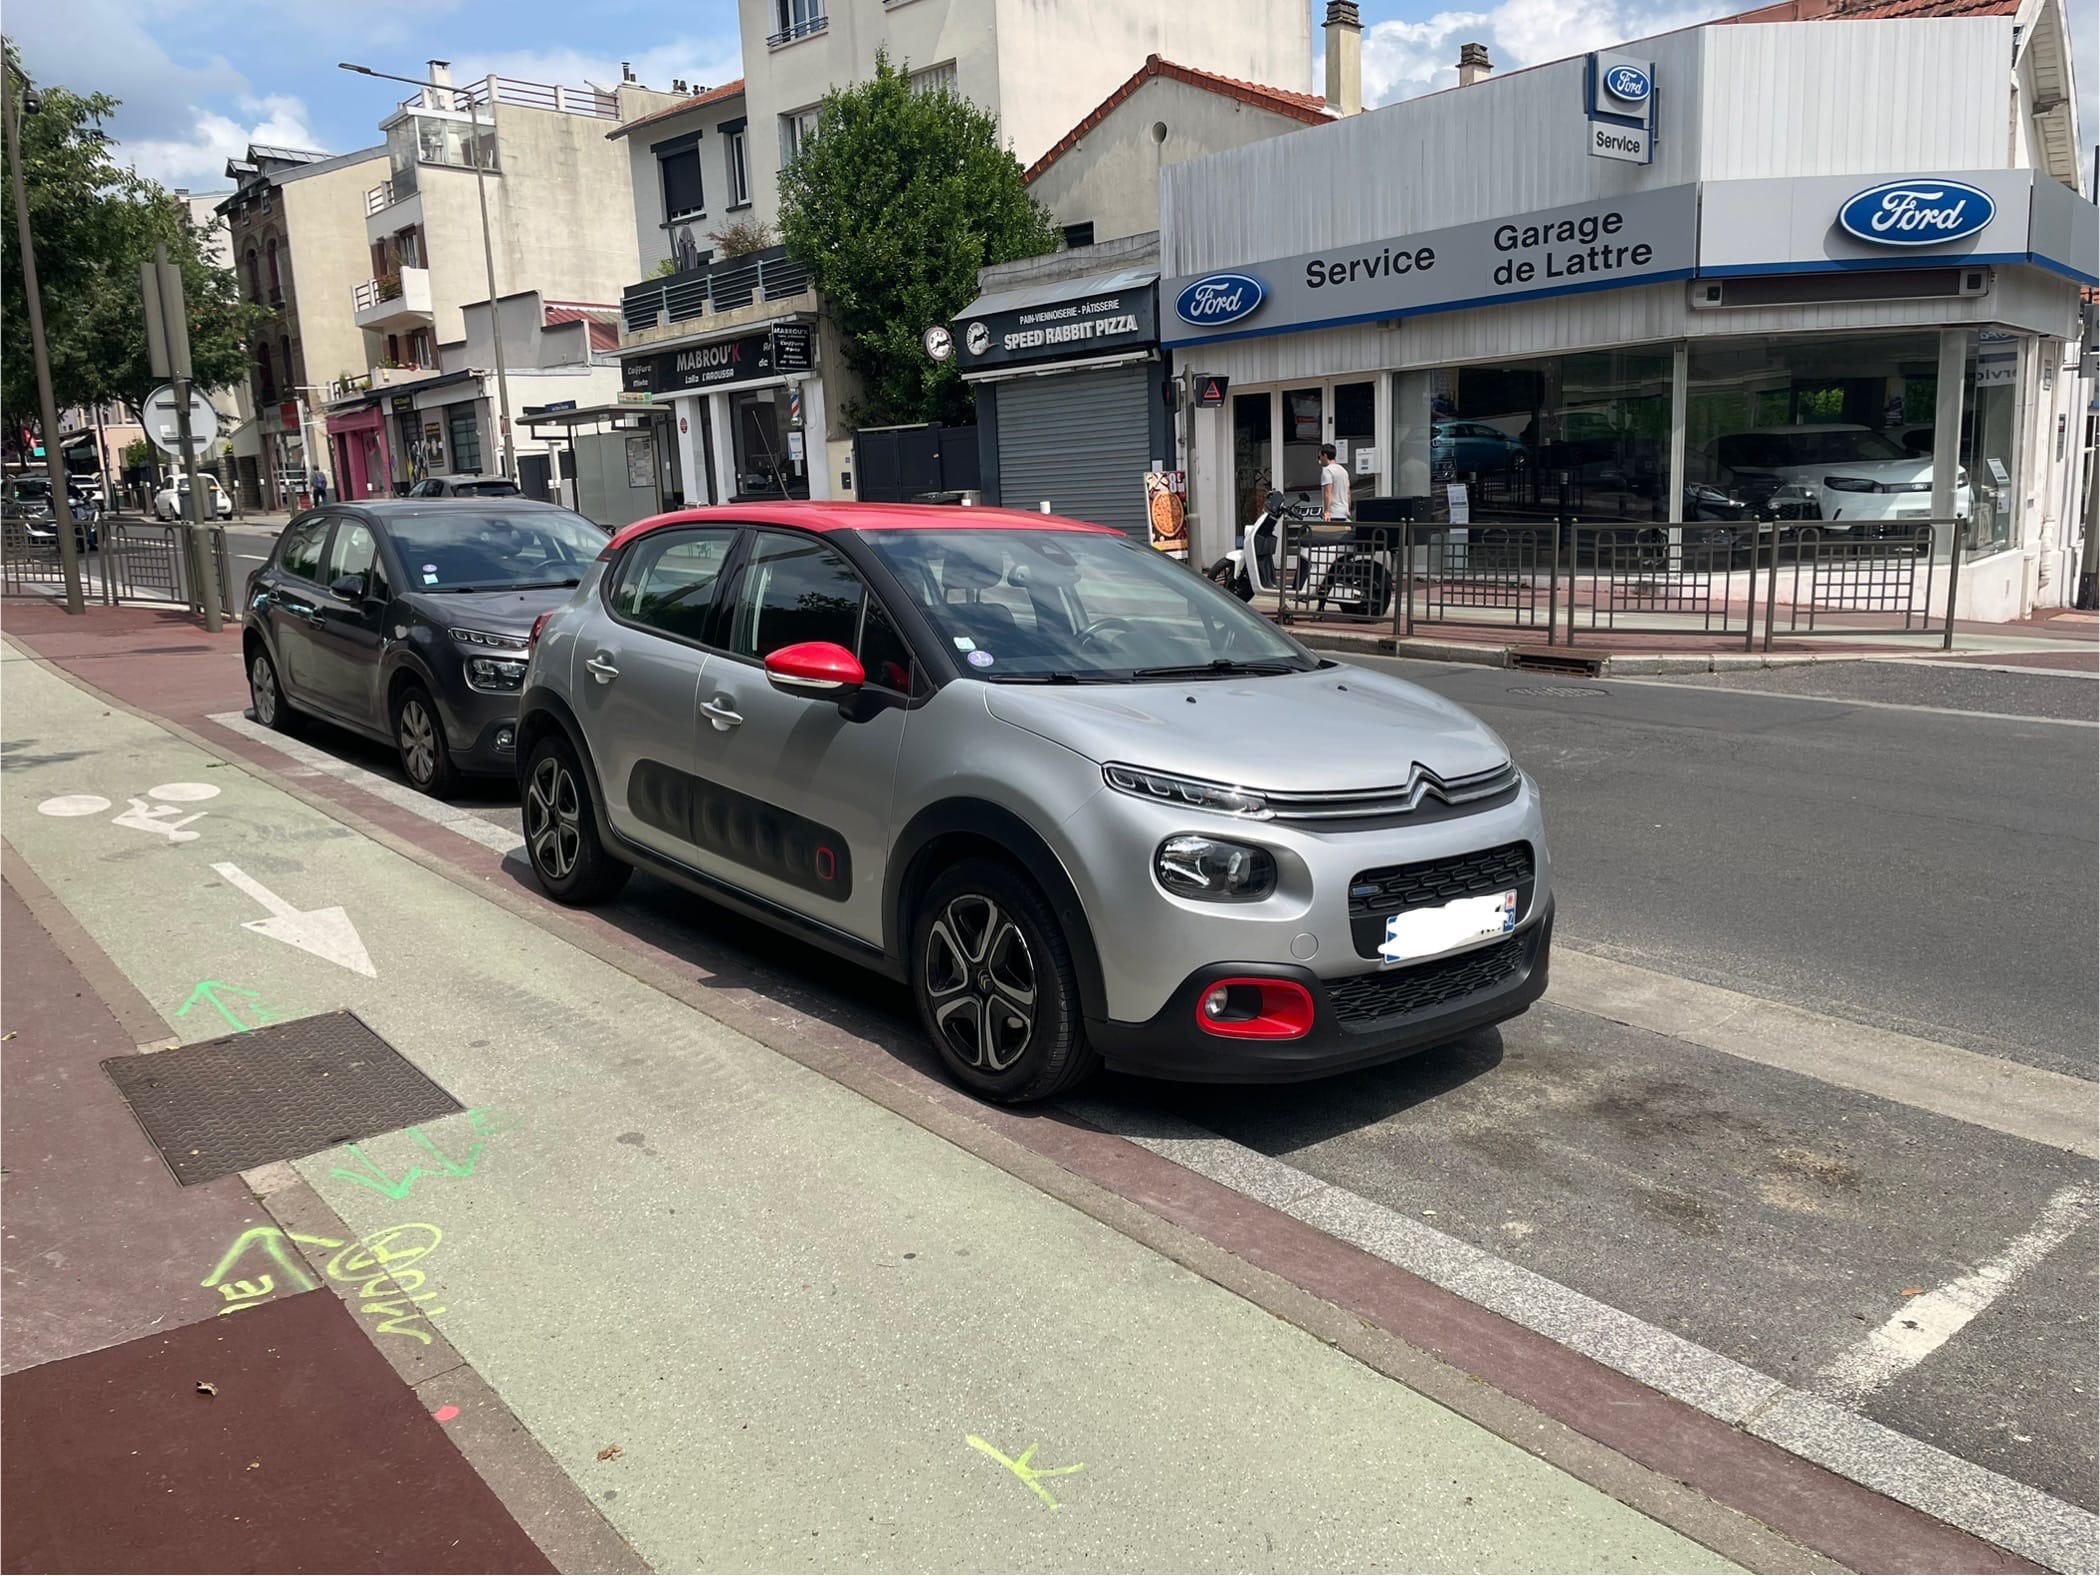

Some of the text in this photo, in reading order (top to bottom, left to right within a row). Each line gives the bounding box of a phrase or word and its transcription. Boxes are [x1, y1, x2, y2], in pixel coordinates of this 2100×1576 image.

[1616, 69, 1643, 95] Ford
[1596, 131, 1640, 153] Service
[1871, 189, 1967, 232] Ford
[1494, 211, 1624, 252] Garage
[1306, 246, 1436, 288] Service
[1493, 243, 1653, 286] de Lattre
[1190, 282, 1242, 317] Ford
[1004, 330, 1045, 350] SPEED
[1045, 321, 1095, 344] RABBIT
[1096, 314, 1138, 337] PIZZA
[676, 344, 741, 372] MABROU'K
